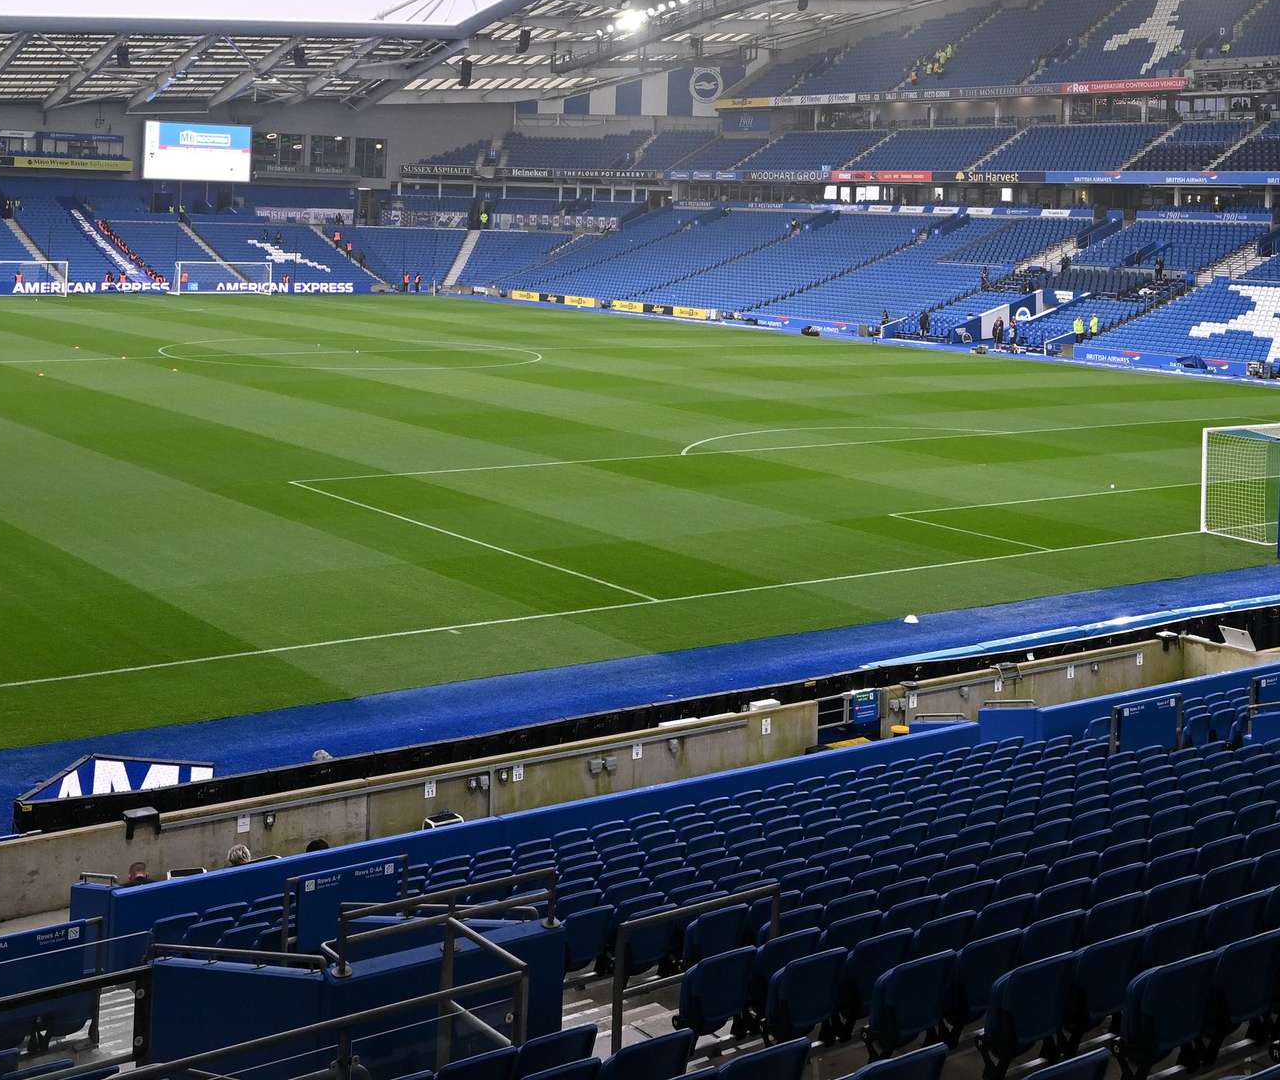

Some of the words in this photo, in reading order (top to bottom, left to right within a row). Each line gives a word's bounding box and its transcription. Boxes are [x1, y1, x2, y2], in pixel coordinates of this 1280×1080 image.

[1072, 83, 1089, 93] Rex
[1125, 81, 1159, 89] CONTROLLED
[403, 164, 431, 174] SUSSEX
[751, 171, 795, 180] WOODHART
[797, 172, 829, 181] GROUP
[968, 172, 984, 181] Sun
[986, 172, 1019, 182] Harvest
[13, 282, 96, 293] AMERICAN
[101, 282, 170, 293] EXPRESS
[216, 283, 288, 293] AMERICAN
[294, 283, 354, 293] EXPRESS
[1086, 353, 1107, 361] BRITISH
[427, 790, 434, 798] 11
[37, 933, 53, 941] Rows
[54, 930, 65, 939] A-F
